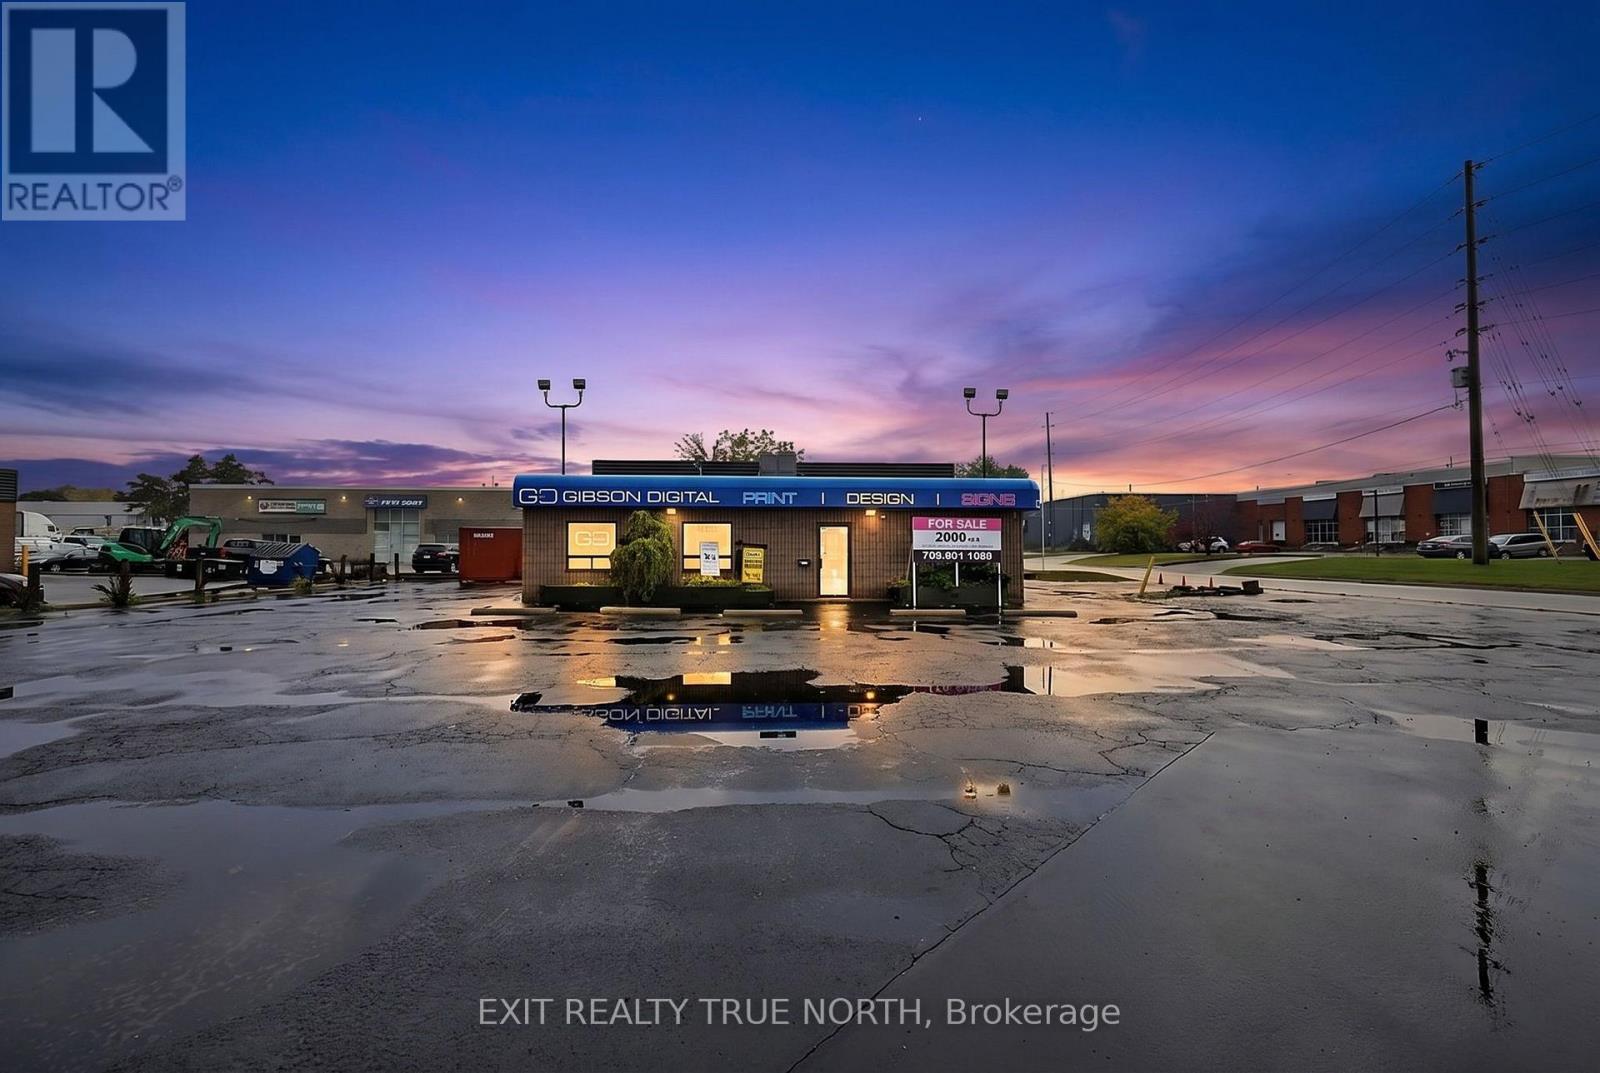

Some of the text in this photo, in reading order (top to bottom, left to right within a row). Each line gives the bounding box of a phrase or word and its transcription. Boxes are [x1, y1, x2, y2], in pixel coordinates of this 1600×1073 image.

[562, 490, 641, 503] GIBSON
[647, 490, 720, 504] DIGITAL
[742, 491, 797, 505] PRINT
[847, 492, 914, 505] DESIGN
[961, 493, 1016, 506] SIGNS
[928, 518, 987, 529] FOR SALE
[935, 532, 967, 543] 2000
